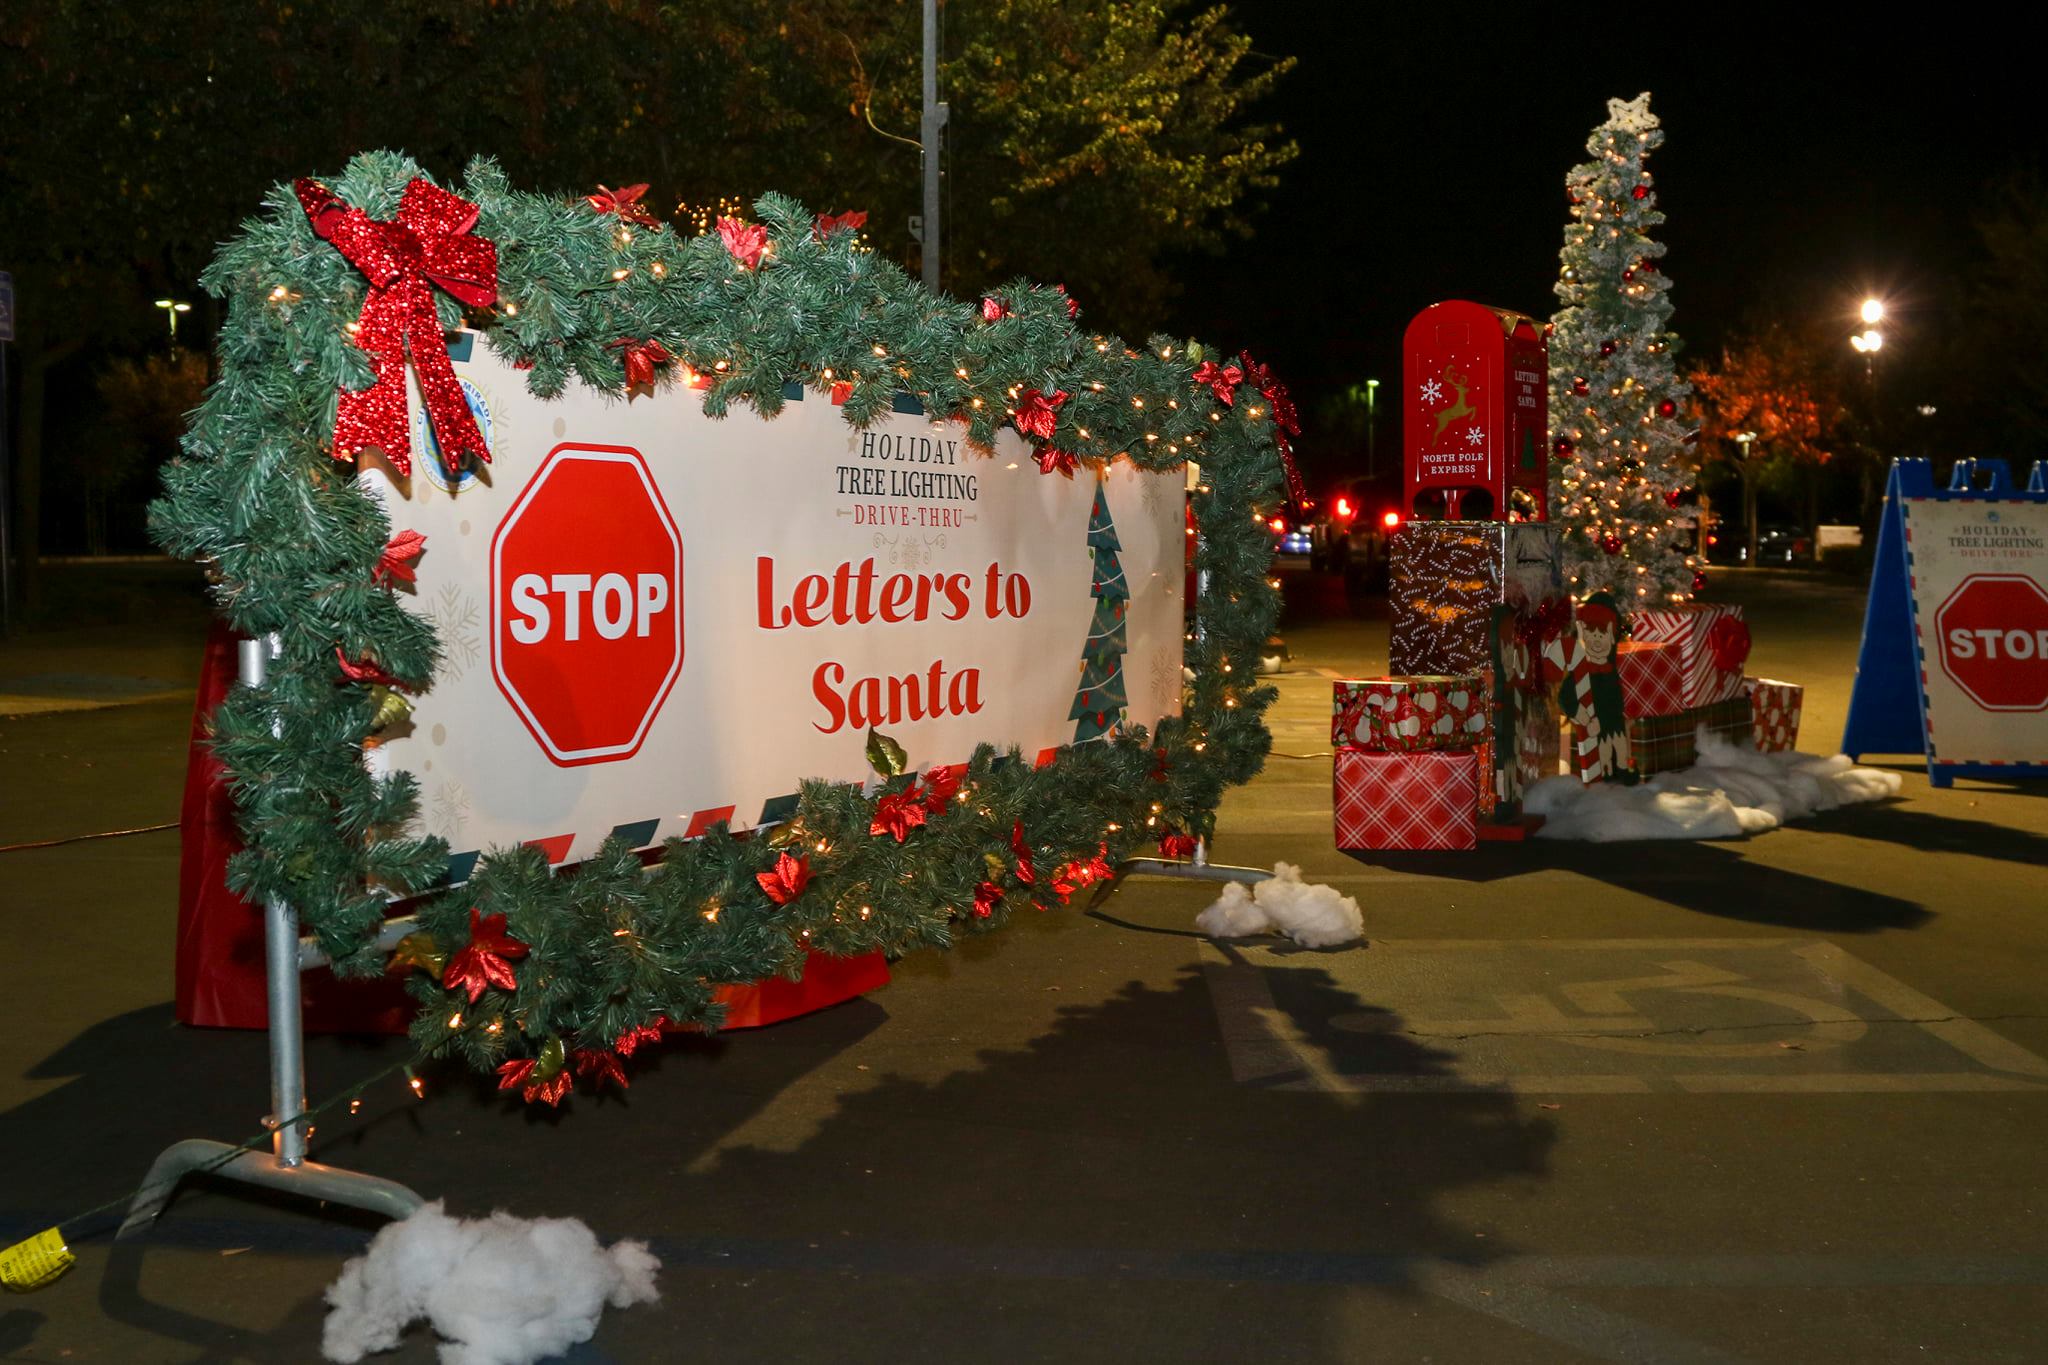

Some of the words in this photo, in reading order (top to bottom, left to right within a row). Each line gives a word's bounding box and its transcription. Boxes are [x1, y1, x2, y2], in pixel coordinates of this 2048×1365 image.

[461, 381, 493, 428] MIRADA
[860, 431, 958, 465] HOLIDAY
[1422, 453, 1456, 463] NORTH
[1458, 452, 1484, 462] POLE
[836, 465, 886, 496] TREE
[890, 470, 978, 501] LIGHTING
[1431, 464, 1476, 474] EXPRESS
[854, 504, 963, 528] DRIVE-THRU
[1961, 525, 2028, 536] HOLIDAY
[1948, 536, 1981, 548] TREE
[1983, 537, 2044, 549] LIGHTING
[508, 572, 669, 645] STOP
[756, 556, 971, 630] Letters
[985, 562, 1032, 619] to
[811, 659, 986, 734] Santa
